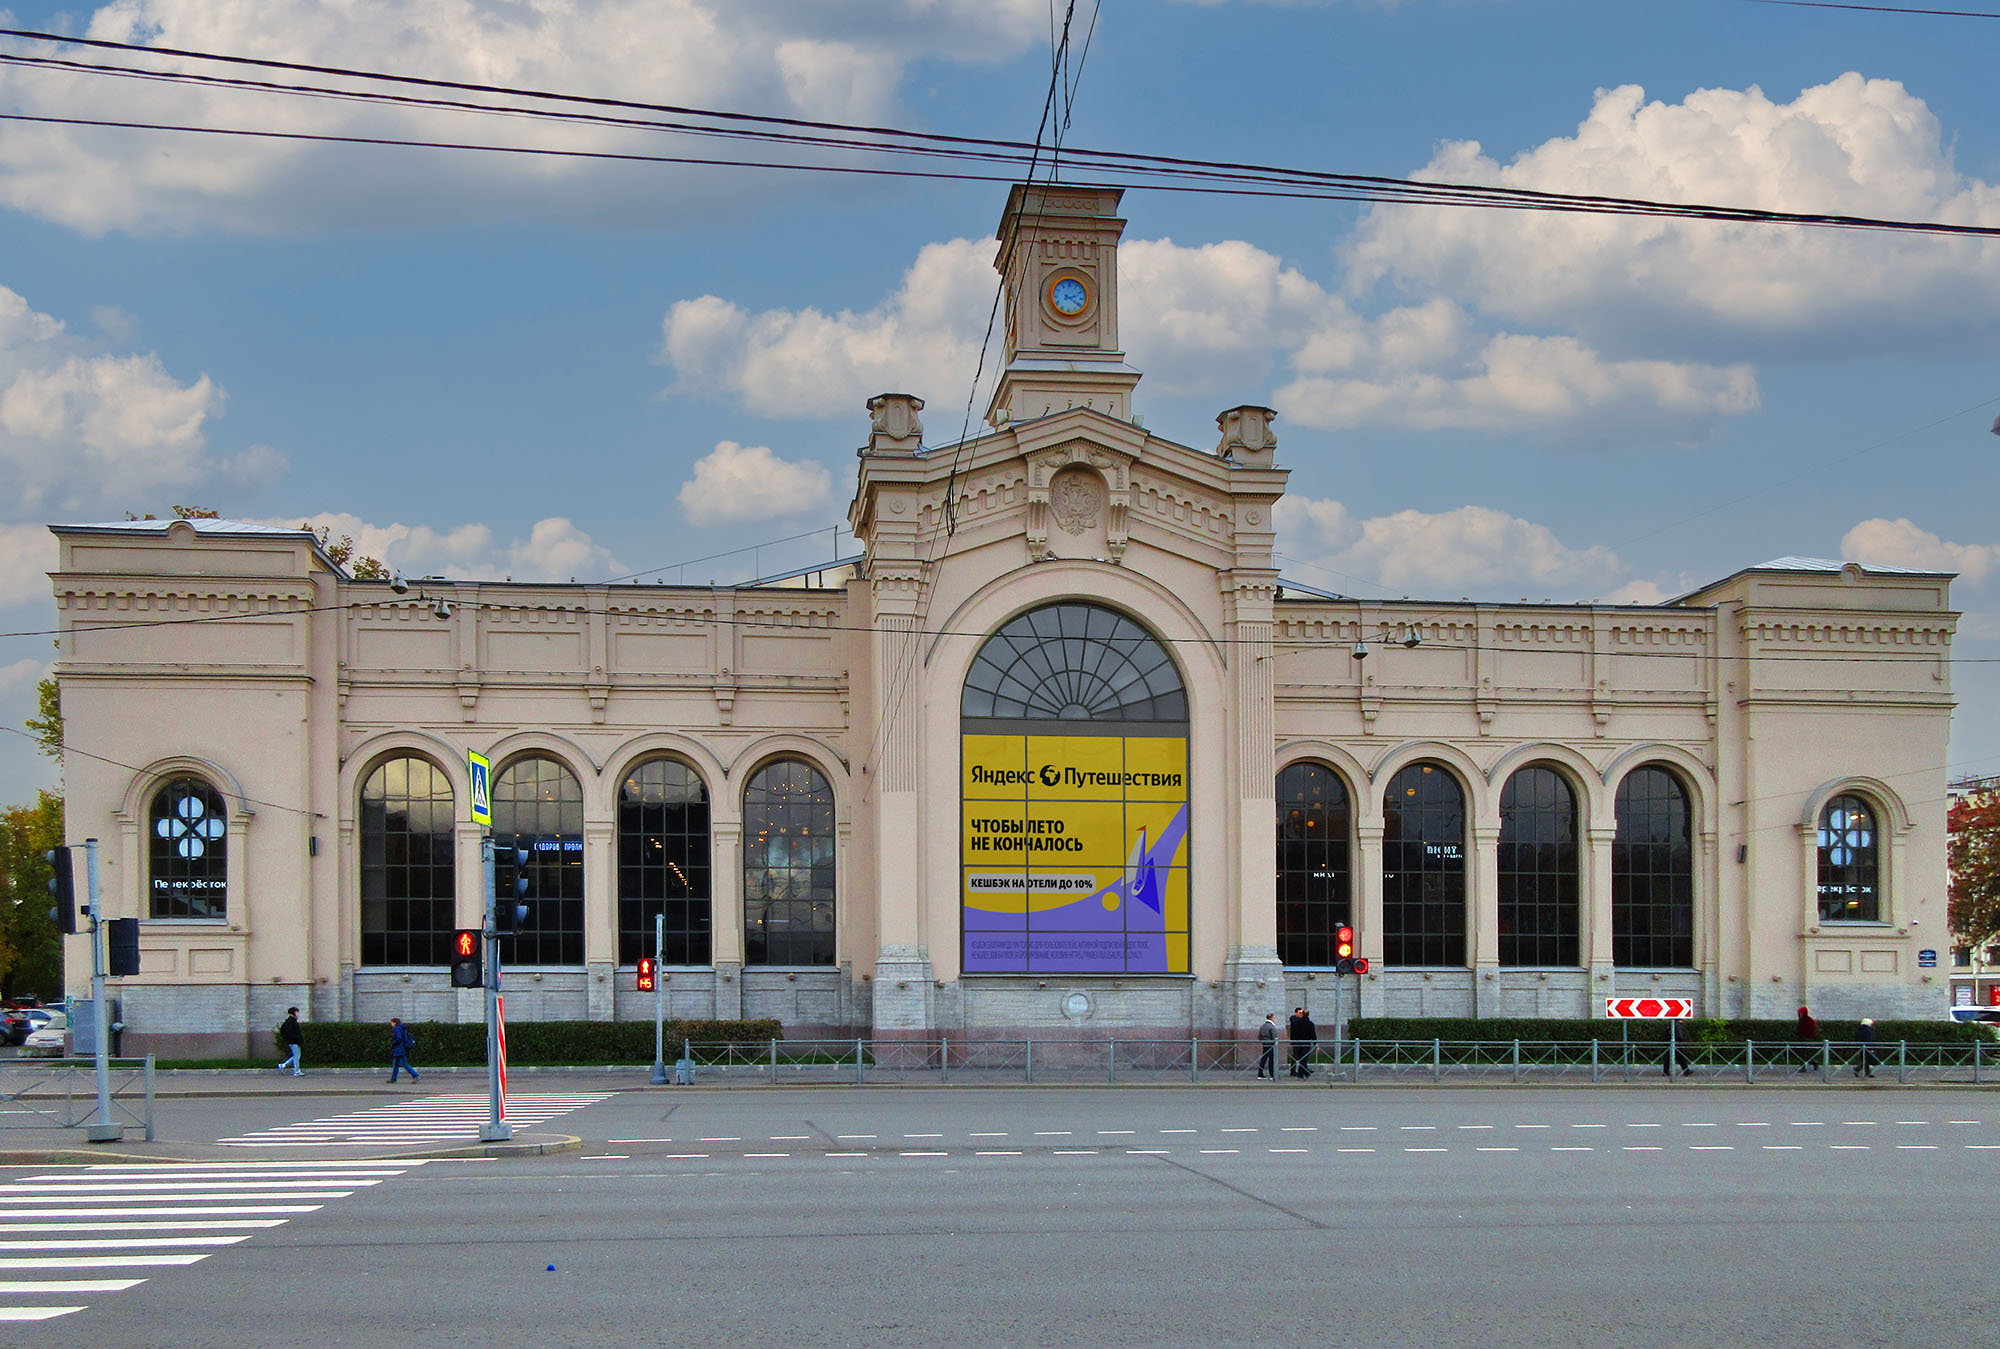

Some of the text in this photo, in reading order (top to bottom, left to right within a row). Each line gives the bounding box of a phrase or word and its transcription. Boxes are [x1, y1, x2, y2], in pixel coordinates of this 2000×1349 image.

[971, 765, 1182, 788] Яндекс Путешествия
[971, 819, 1065, 834] ЧТОБЫ ЛЕТО
[971, 837, 1084, 852] НЕ КОНЧАЛОСЬ
[154, 880, 227, 888] Пеекёсток
[971, 878, 1093, 890] КЕШБЭК НА ОТЕЛИ ДО 10%
